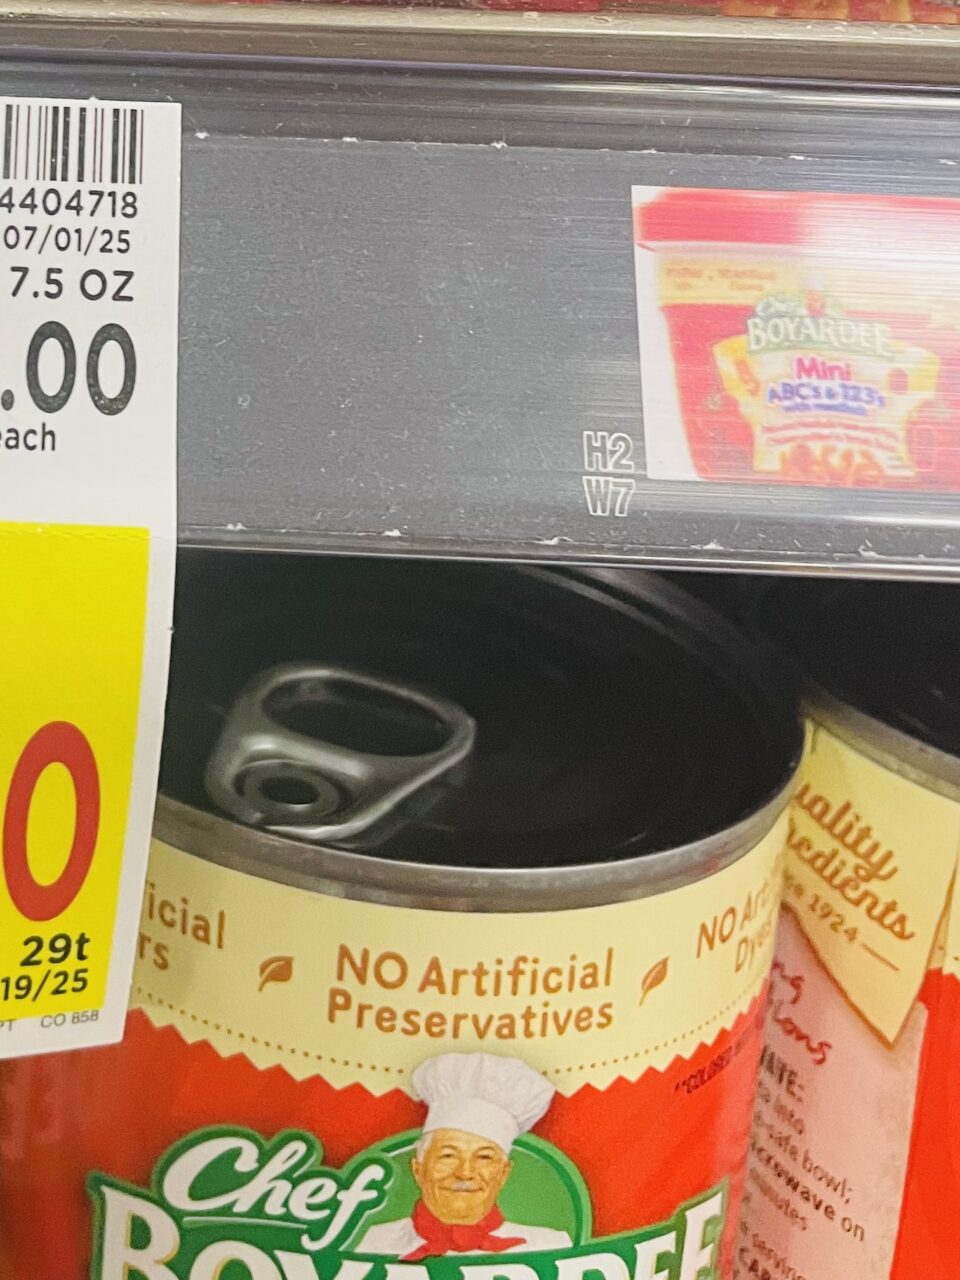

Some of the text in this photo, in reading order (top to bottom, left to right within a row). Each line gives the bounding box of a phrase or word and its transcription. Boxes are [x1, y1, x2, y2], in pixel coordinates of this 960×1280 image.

[3, 224, 131, 257] 07/01/25
[9, 265, 64, 299] 7.5
[79, 269, 135, 302] OZ
[747, 317, 893, 357] BOYARDEE
[796, 357, 852, 382] Mini
[582, 430, 635, 472] H2
[582, 475, 636, 517] W7
[19, 932, 91, 968] 29t
[696, 906, 736, 959] NO
[336, 943, 614, 998] NO Artificial
[40, 1013, 67, 1029] CO
[71, 1009, 100, 1024] 858
[326, 986, 614, 1040] Preservatives
[162, 1135, 384, 1252] Chef
[841, 1216, 865, 1242] on
